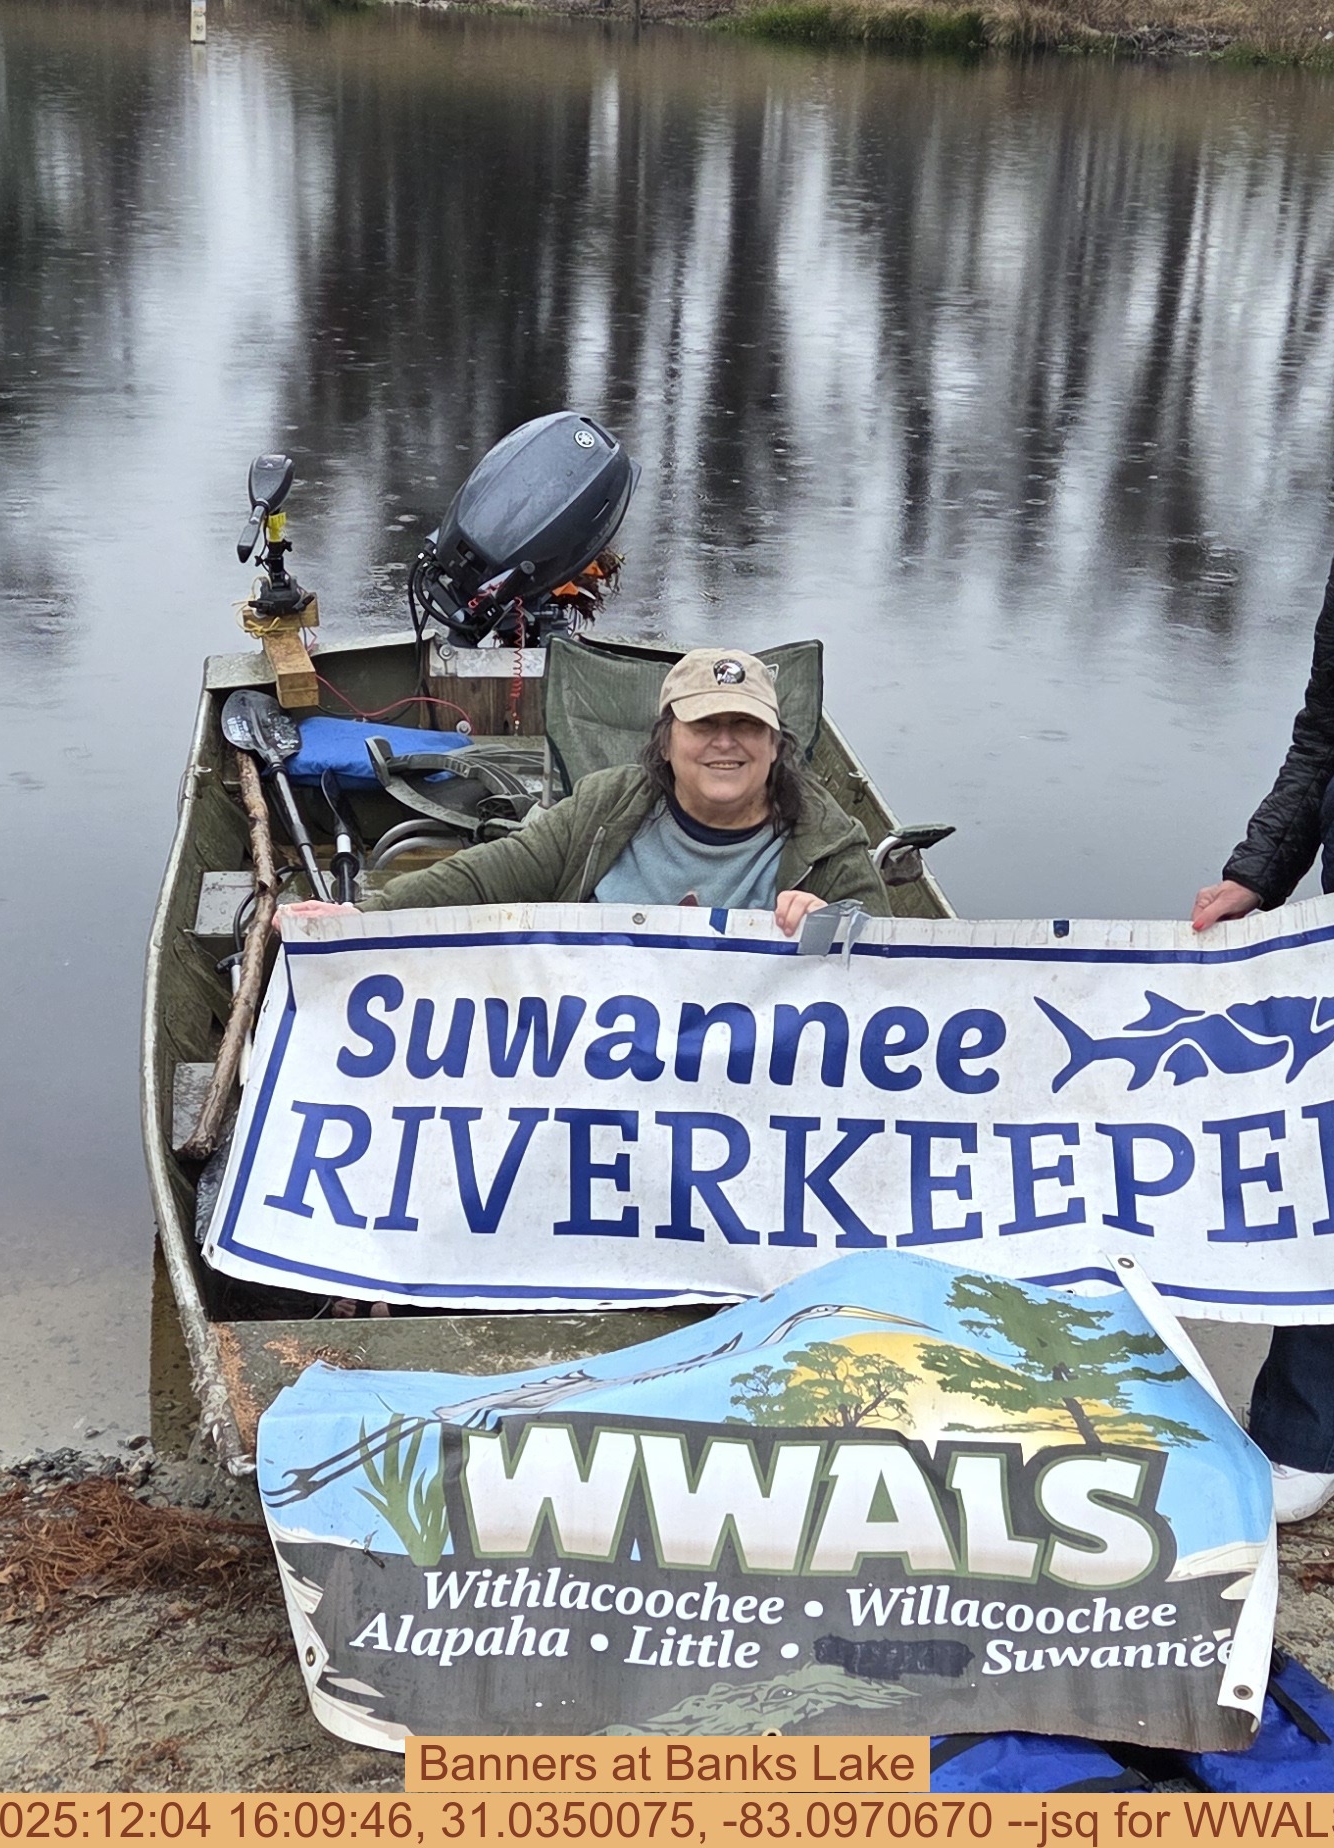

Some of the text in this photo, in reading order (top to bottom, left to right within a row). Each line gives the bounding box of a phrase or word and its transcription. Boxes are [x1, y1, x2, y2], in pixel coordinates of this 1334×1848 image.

[336, 974, 1006, 1094] Suwannee
[461, 1422, 1160, 1590] WWALS
[349, 1611, 570, 1666] Alapaha
[624, 1624, 761, 1669] Little
[423, 1566, 1178, 1635] Withlacoochee Willacoochee
